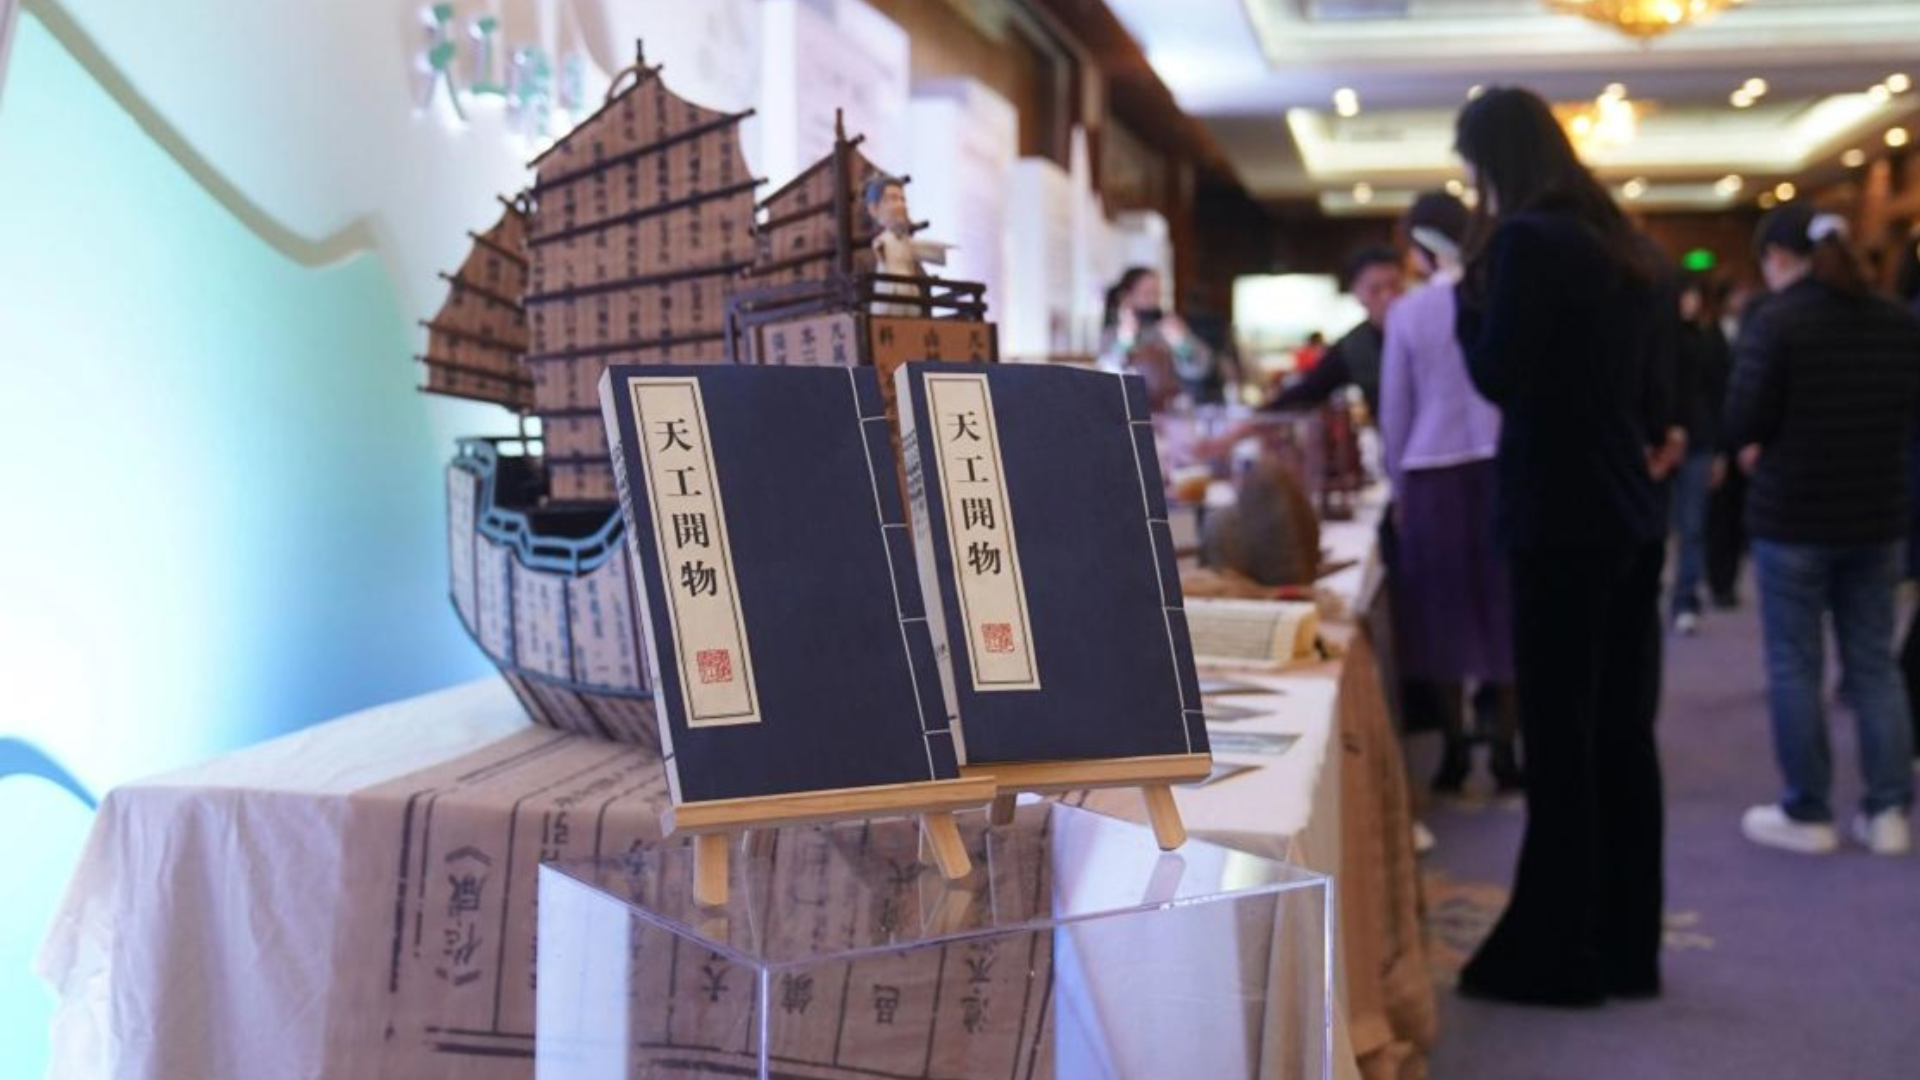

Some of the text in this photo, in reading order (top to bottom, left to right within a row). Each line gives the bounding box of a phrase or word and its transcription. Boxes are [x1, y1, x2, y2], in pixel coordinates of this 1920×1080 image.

[655, 418, 718, 597] 天工開物
[947, 411, 1001, 576] 天工開物
